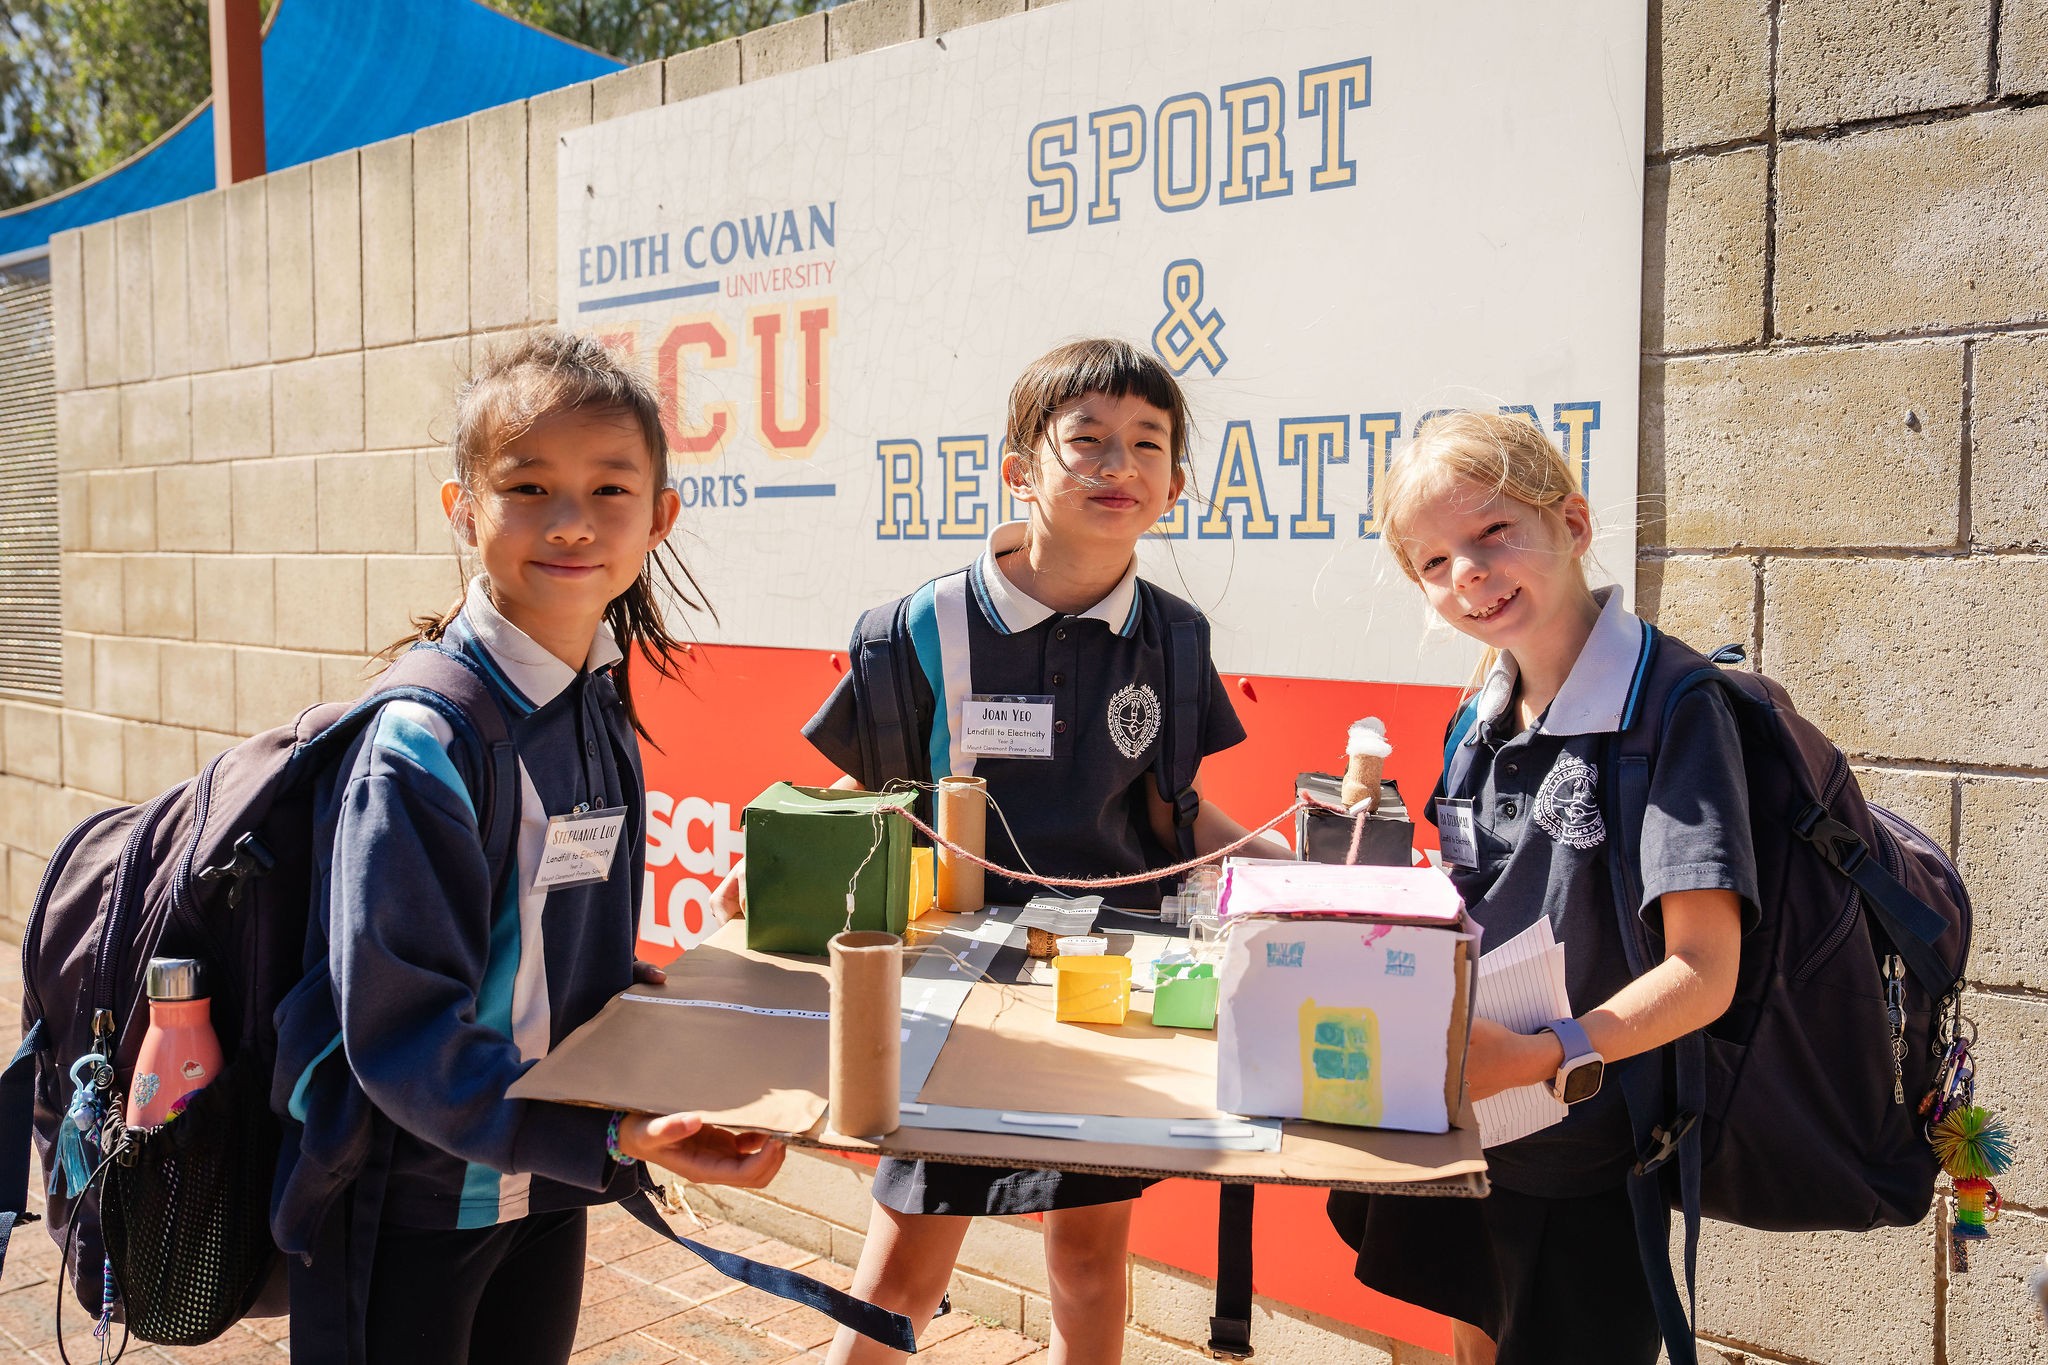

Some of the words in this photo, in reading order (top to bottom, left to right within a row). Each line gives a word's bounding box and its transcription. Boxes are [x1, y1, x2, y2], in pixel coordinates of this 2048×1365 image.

[1027, 56, 1372, 234] SPORT
[579, 233, 669, 288] EDITH
[684, 201, 836, 270] COWAN
[726, 260, 836, 298] UNIVERSITY
[1152, 258, 1229, 377] &
[594, 297, 837, 462] CU
[666, 474, 748, 508] ORTS
[982, 708, 1008, 721] JOAN
[1013, 709, 1032, 722] YEO
[967, 727, 995, 736] Landfill
[1007, 728, 1046, 740] Electricity
[1547, 768, 1589, 792] CLAREMONT
[552, 827, 599, 845] STEPHANIE
[600, 825, 617, 839] LUO
[546, 853, 571, 864] Landfill
